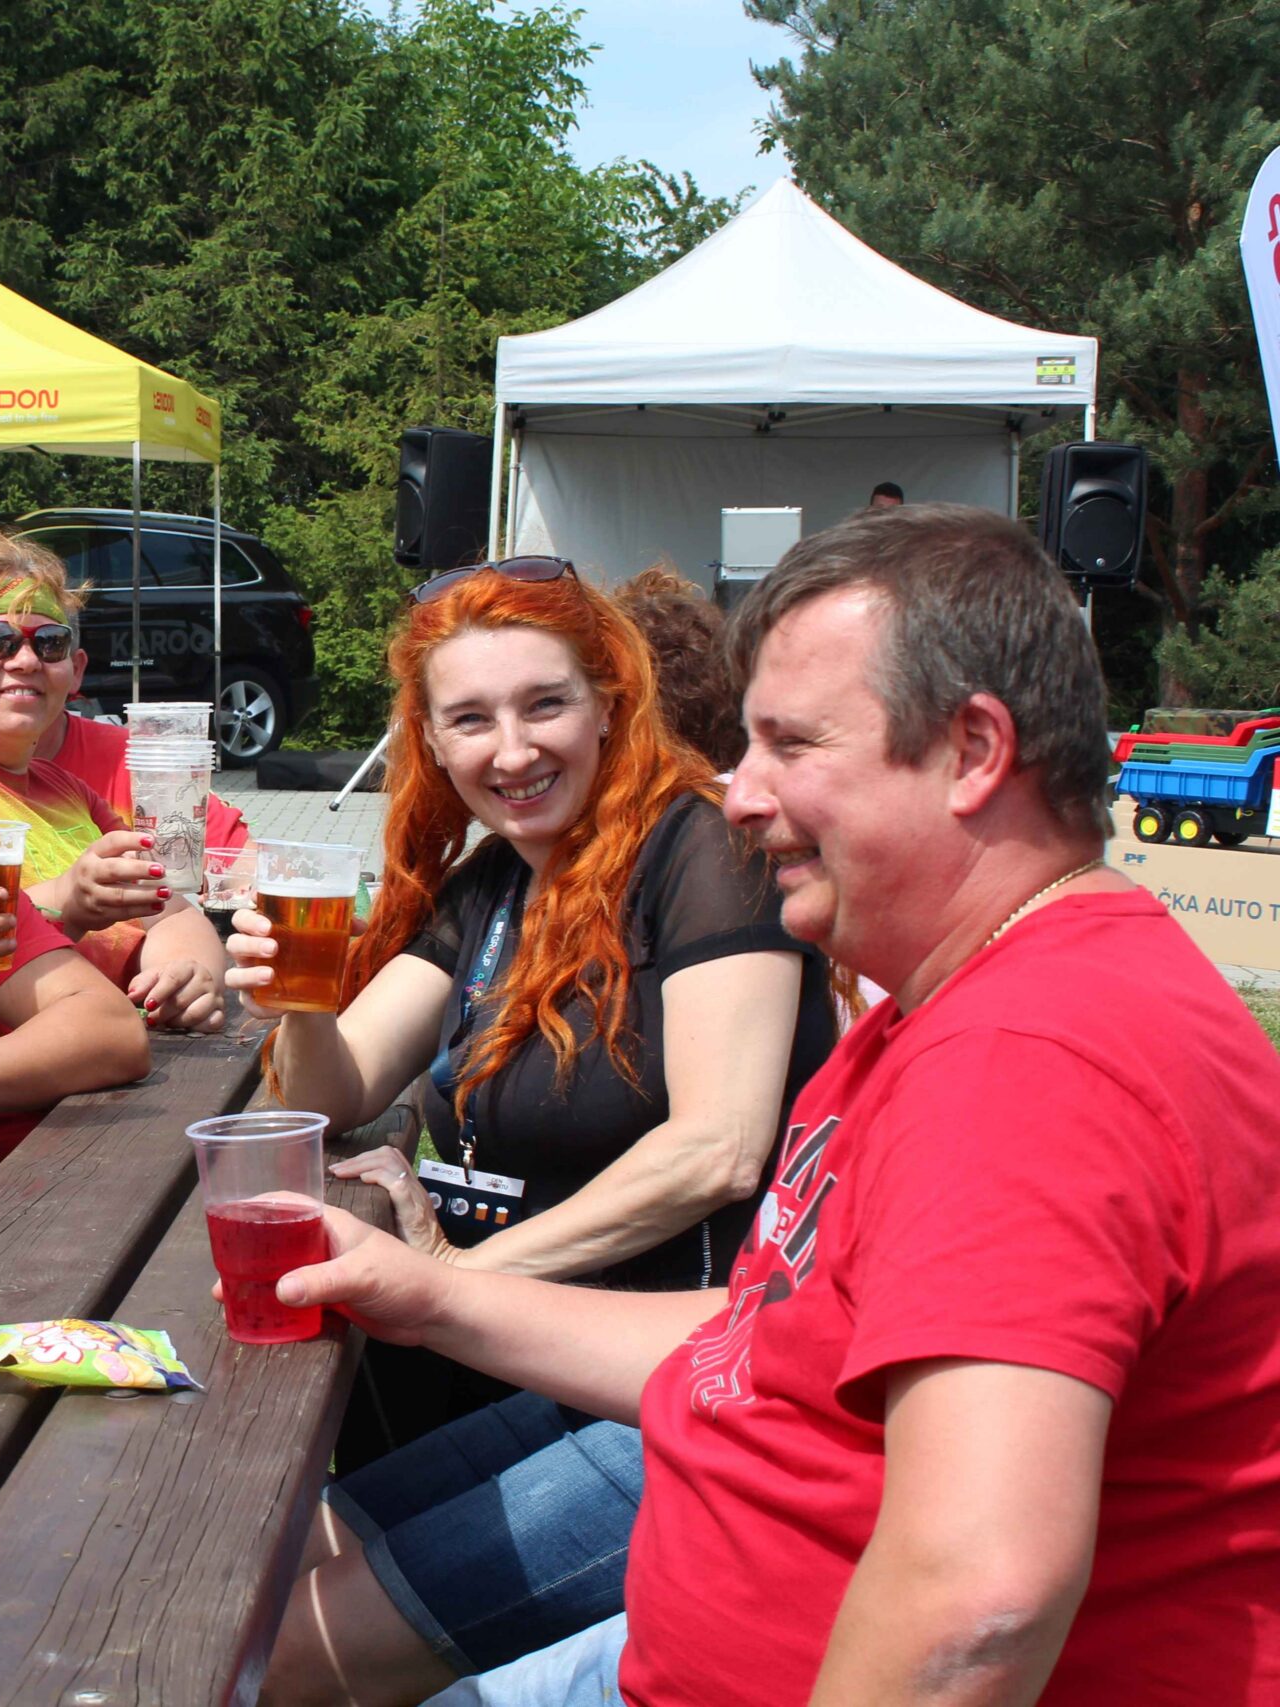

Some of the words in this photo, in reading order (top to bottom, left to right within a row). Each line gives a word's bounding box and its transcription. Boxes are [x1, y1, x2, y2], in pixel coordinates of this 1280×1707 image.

[1152, 887, 1199, 912] ČKA
[1205, 897, 1262, 920] AUTO
[482, 934, 500, 967] GROUP
